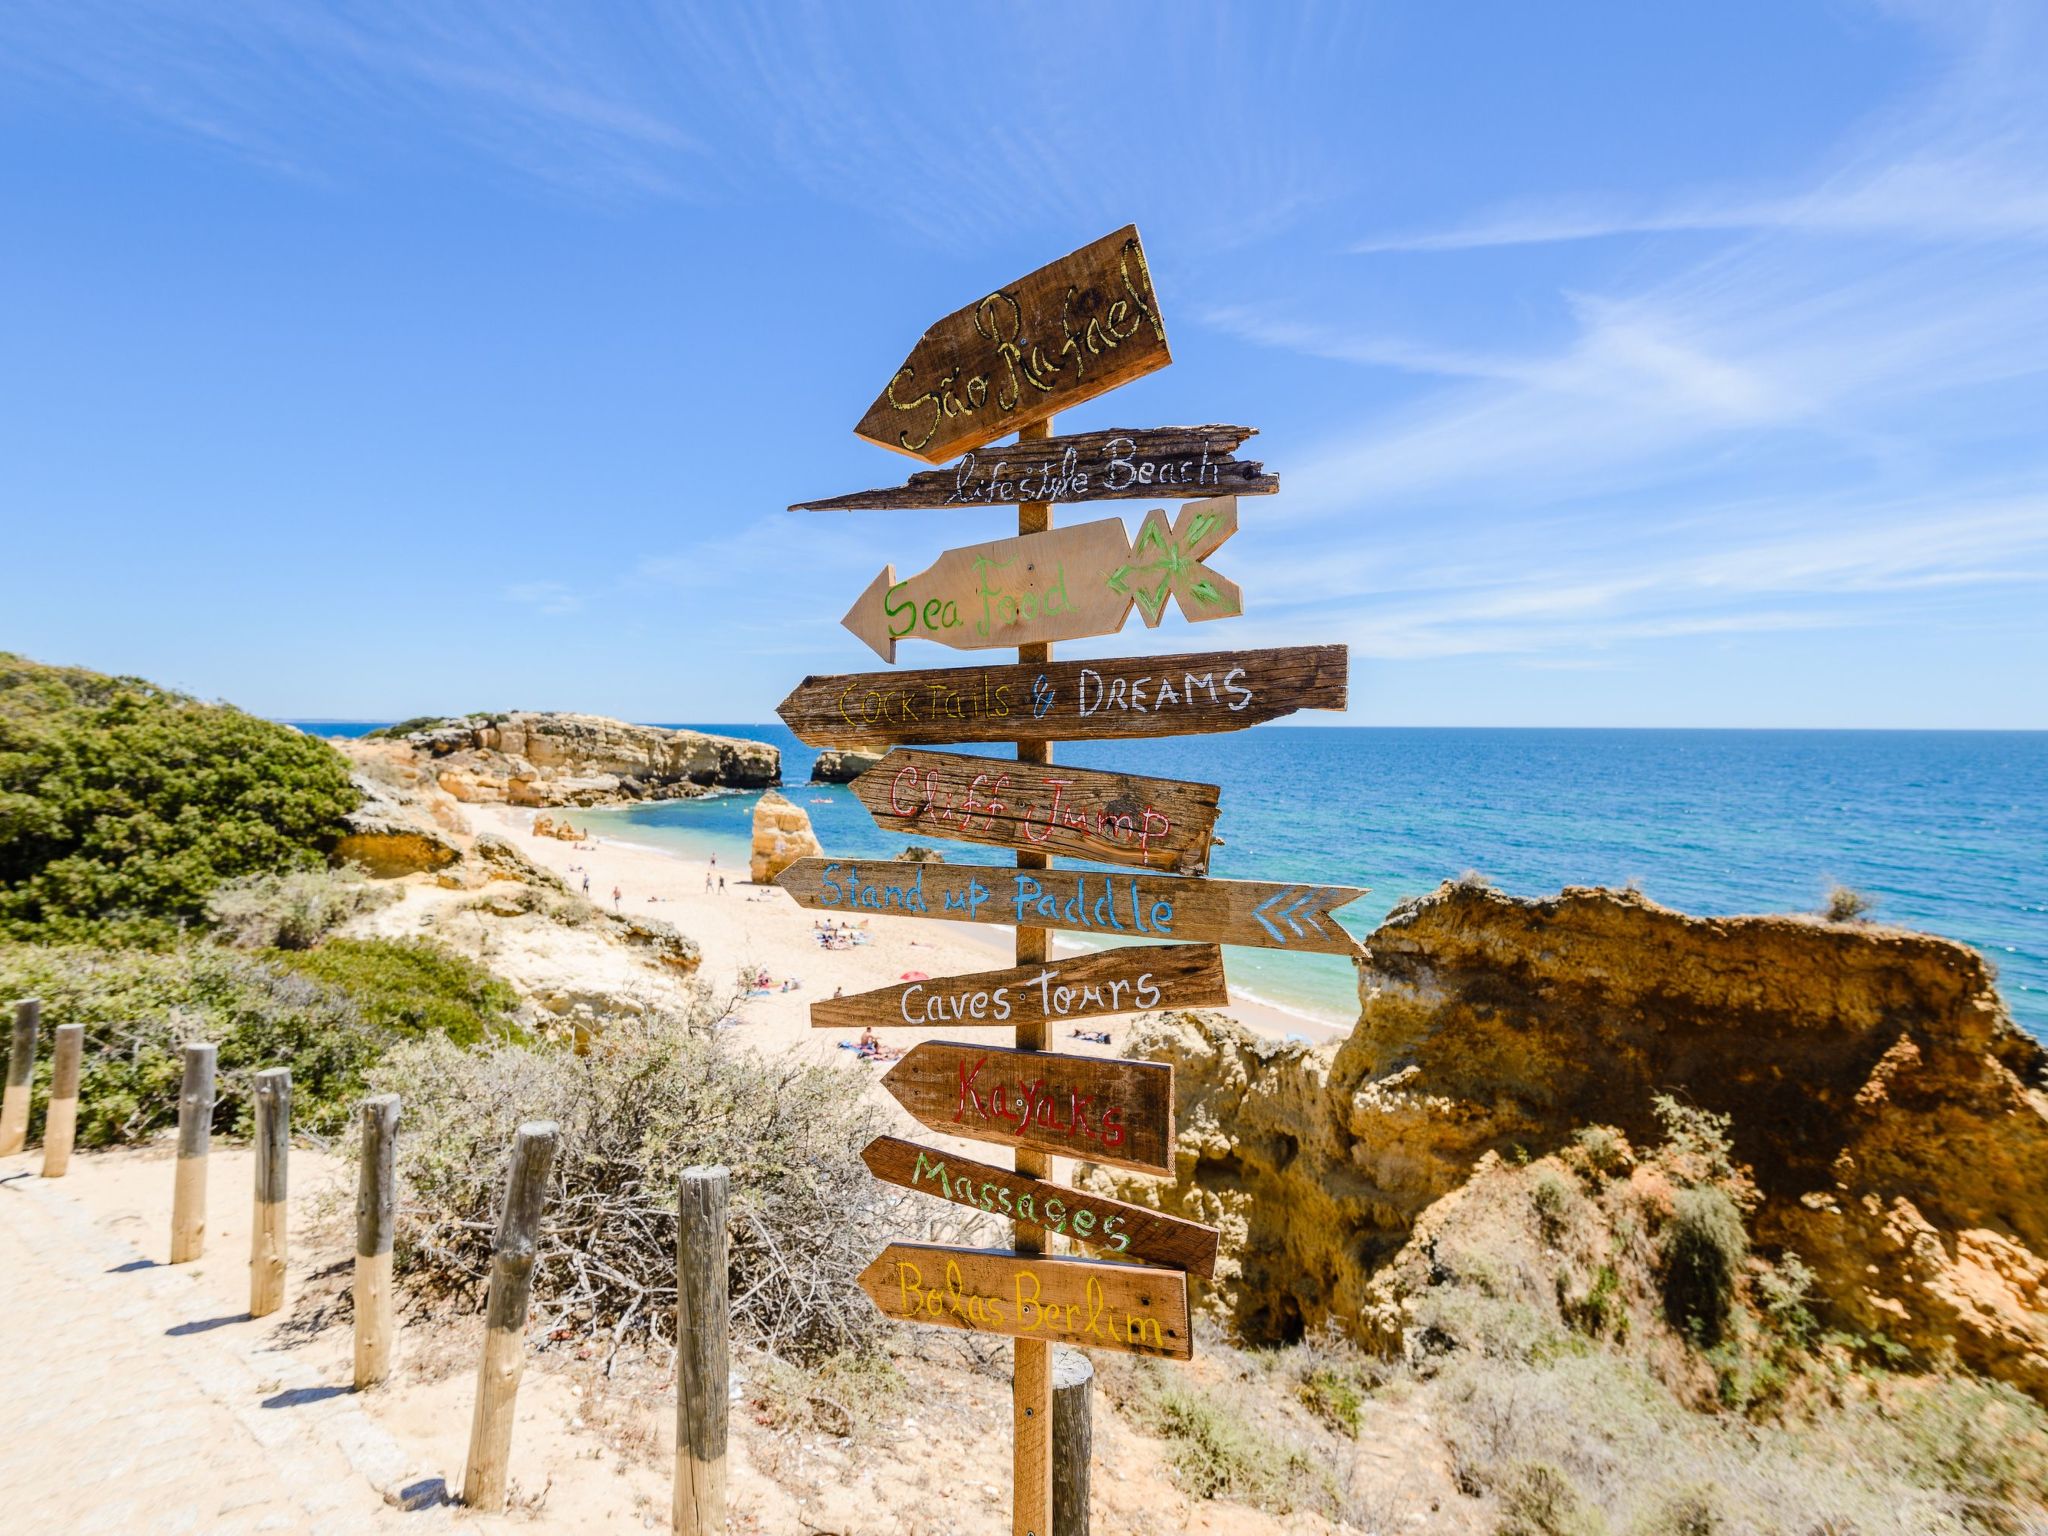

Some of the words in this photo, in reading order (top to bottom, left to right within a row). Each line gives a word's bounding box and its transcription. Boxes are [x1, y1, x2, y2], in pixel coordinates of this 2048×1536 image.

[889, 367, 989, 450] São
[974, 238, 1165, 411] Rafael
[1101, 437, 1218, 491] Beach
[884, 581, 963, 637] Sea
[1031, 674, 1056, 719] &
[1079, 668, 1253, 718] DREAMS
[890, 766, 1010, 832] Cliff
[1023, 778, 1171, 865] Jump
[820, 863, 927, 913] Stand
[945, 875, 992, 920] up
[1012, 873, 1173, 933] Paddle
[901, 984, 1011, 1024] Caves
[1025, 969, 1161, 1017] Tours
[911, 1152, 1131, 1252] Massages
[896, 1259, 1005, 1327] Bolas
[1014, 1270, 1164, 1346] Berlim
